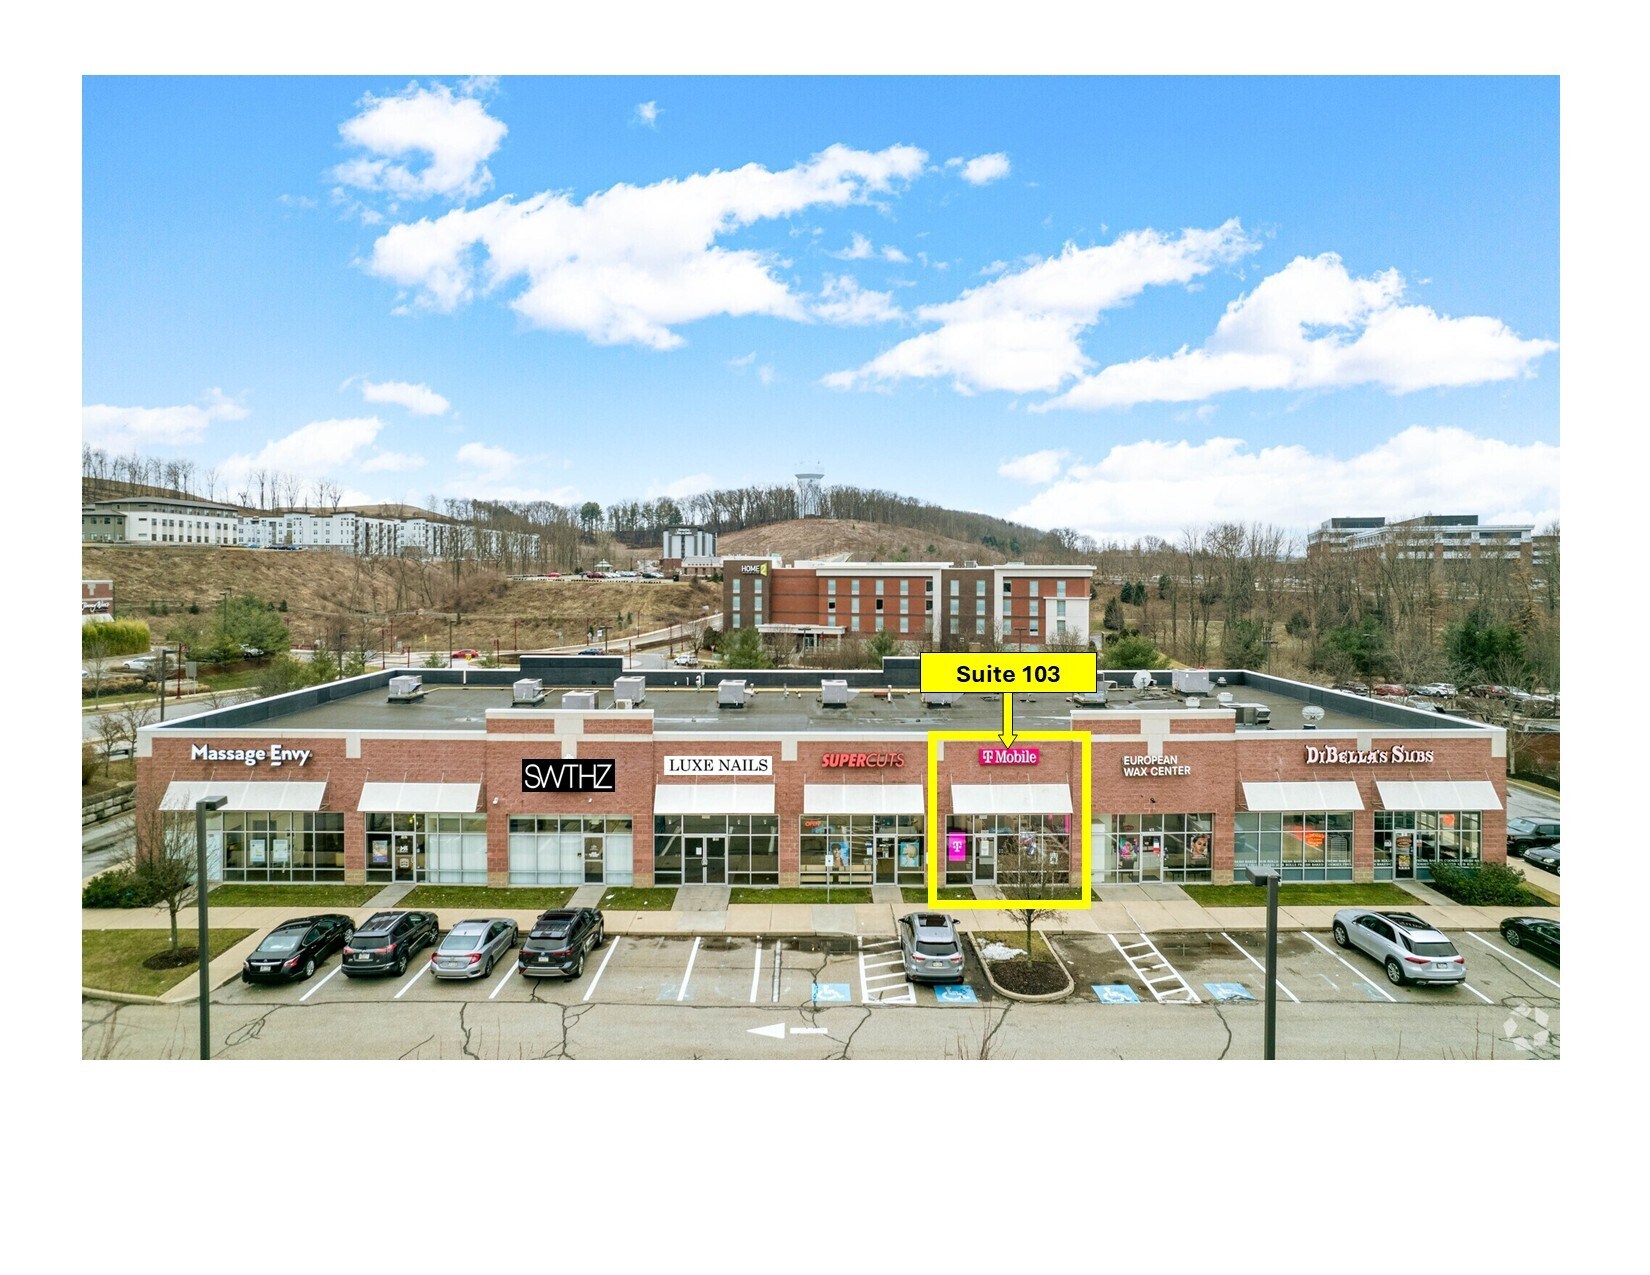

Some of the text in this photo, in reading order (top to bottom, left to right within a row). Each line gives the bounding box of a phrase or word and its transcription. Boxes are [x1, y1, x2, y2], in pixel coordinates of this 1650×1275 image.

[191, 743, 311, 767] Massage Envy
[821, 753, 905, 768] SUPERCUTS
[1123, 755, 1178, 765] EUROPEAN
[669, 758, 769, 772] LUXE NAILS
[1123, 766, 1191, 777] WAX CENTER
[524, 763, 613, 789] SWTHZ
